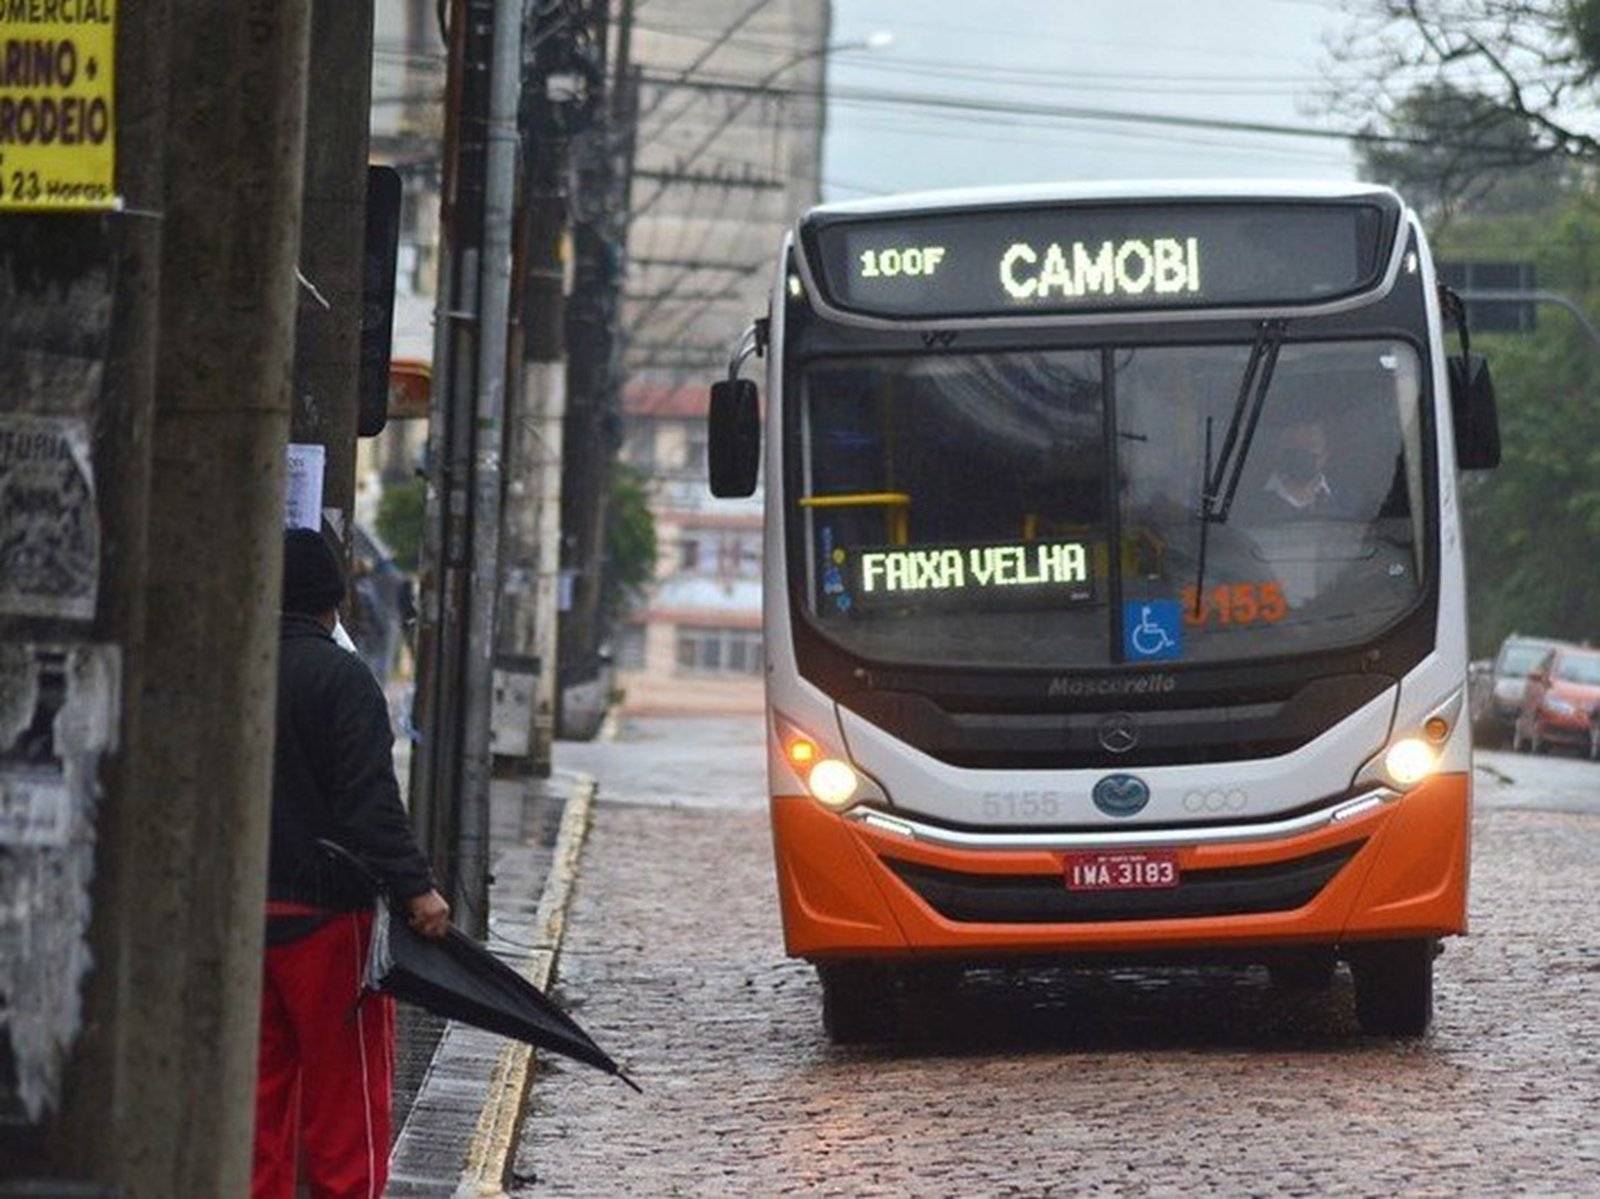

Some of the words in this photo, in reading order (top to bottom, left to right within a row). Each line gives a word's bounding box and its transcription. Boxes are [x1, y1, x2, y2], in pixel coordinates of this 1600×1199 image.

[0, 39, 77, 88] RINO
[0, 96, 108, 145] RODEIO
[12, 171, 40, 200] 23
[860, 247, 945, 277] 100F
[1000, 238, 1199, 298] CAMOBI
[862, 551, 965, 592] FAIXA
[969, 543, 1087, 586] VELHA
[1182, 582, 1287, 626] 5155
[981, 790, 1060, 819] 5155
[1118, 862, 1174, 884] 3183
